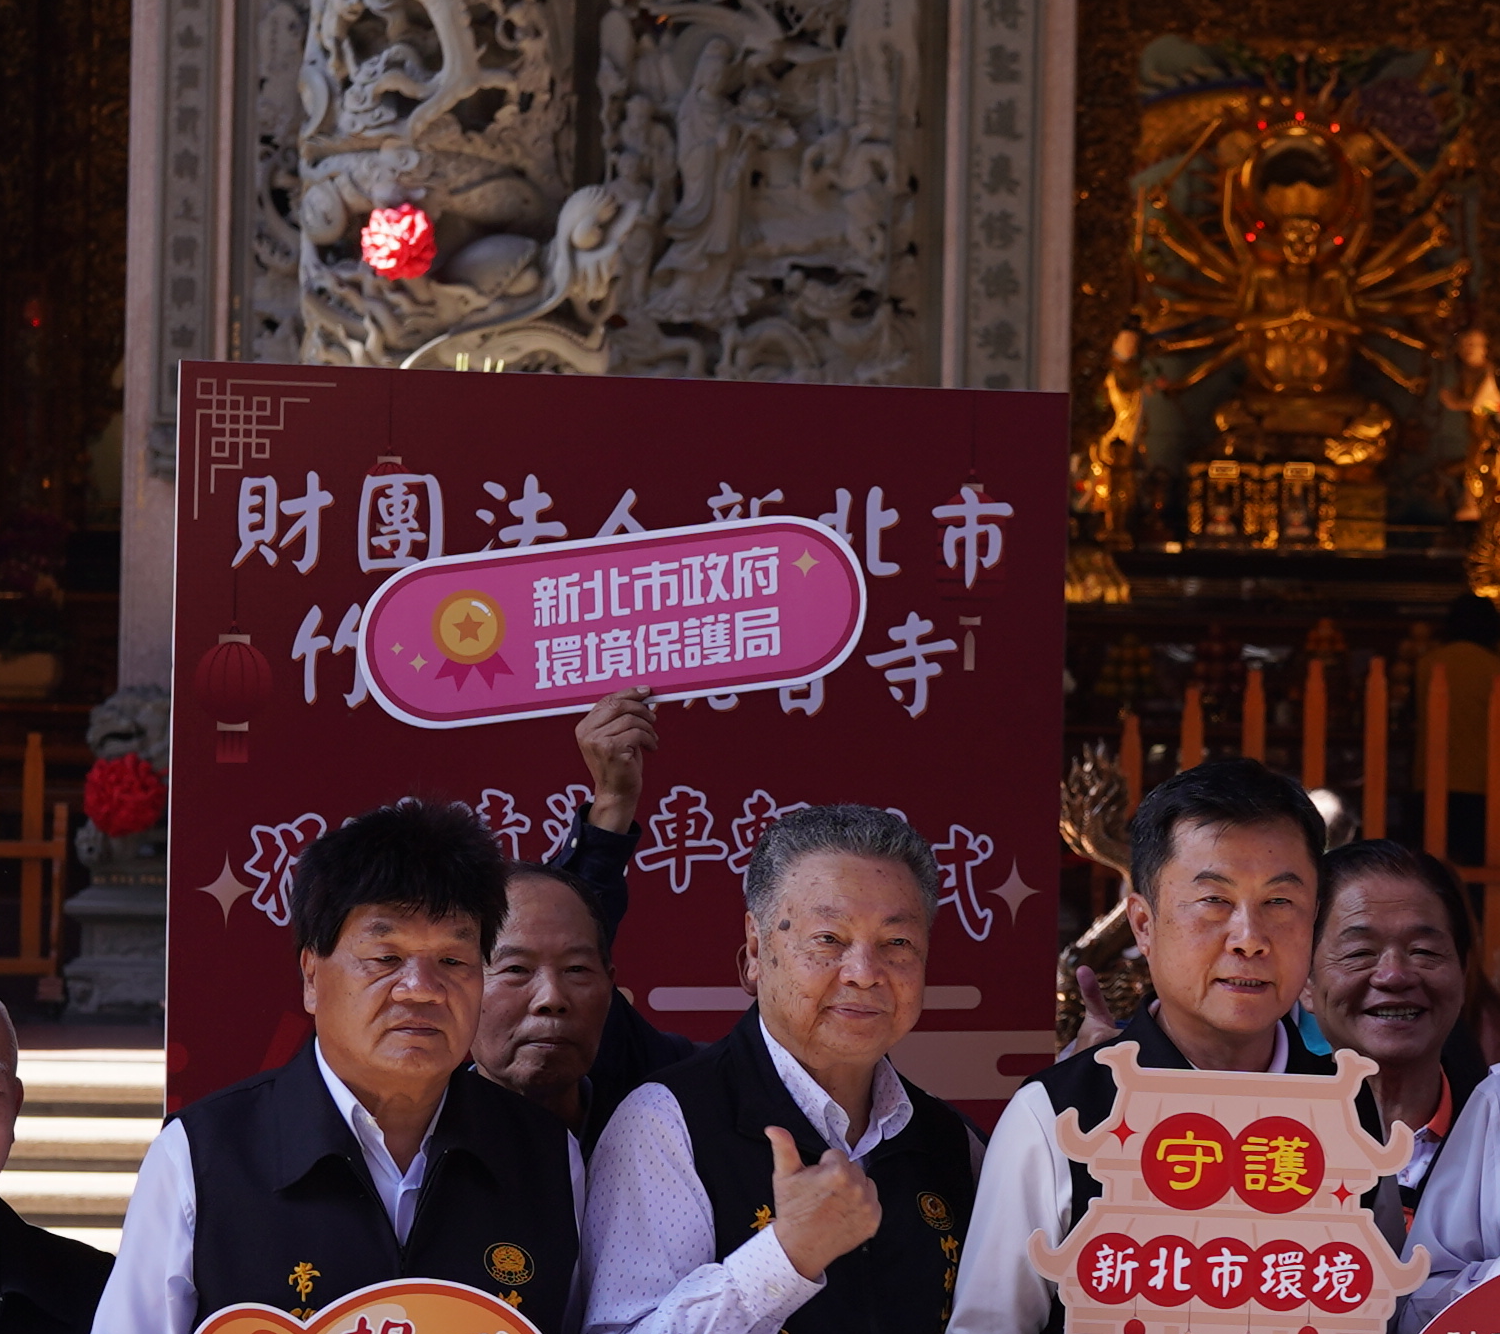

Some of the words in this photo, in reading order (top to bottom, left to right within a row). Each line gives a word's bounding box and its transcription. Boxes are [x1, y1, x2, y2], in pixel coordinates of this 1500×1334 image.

[533, 545, 779, 628] 新北市政府
[534, 610, 782, 692] 環境保護局
[1155, 1130, 1313, 1196] 守護
[1091, 1243, 1362, 1305] 新北市環境
